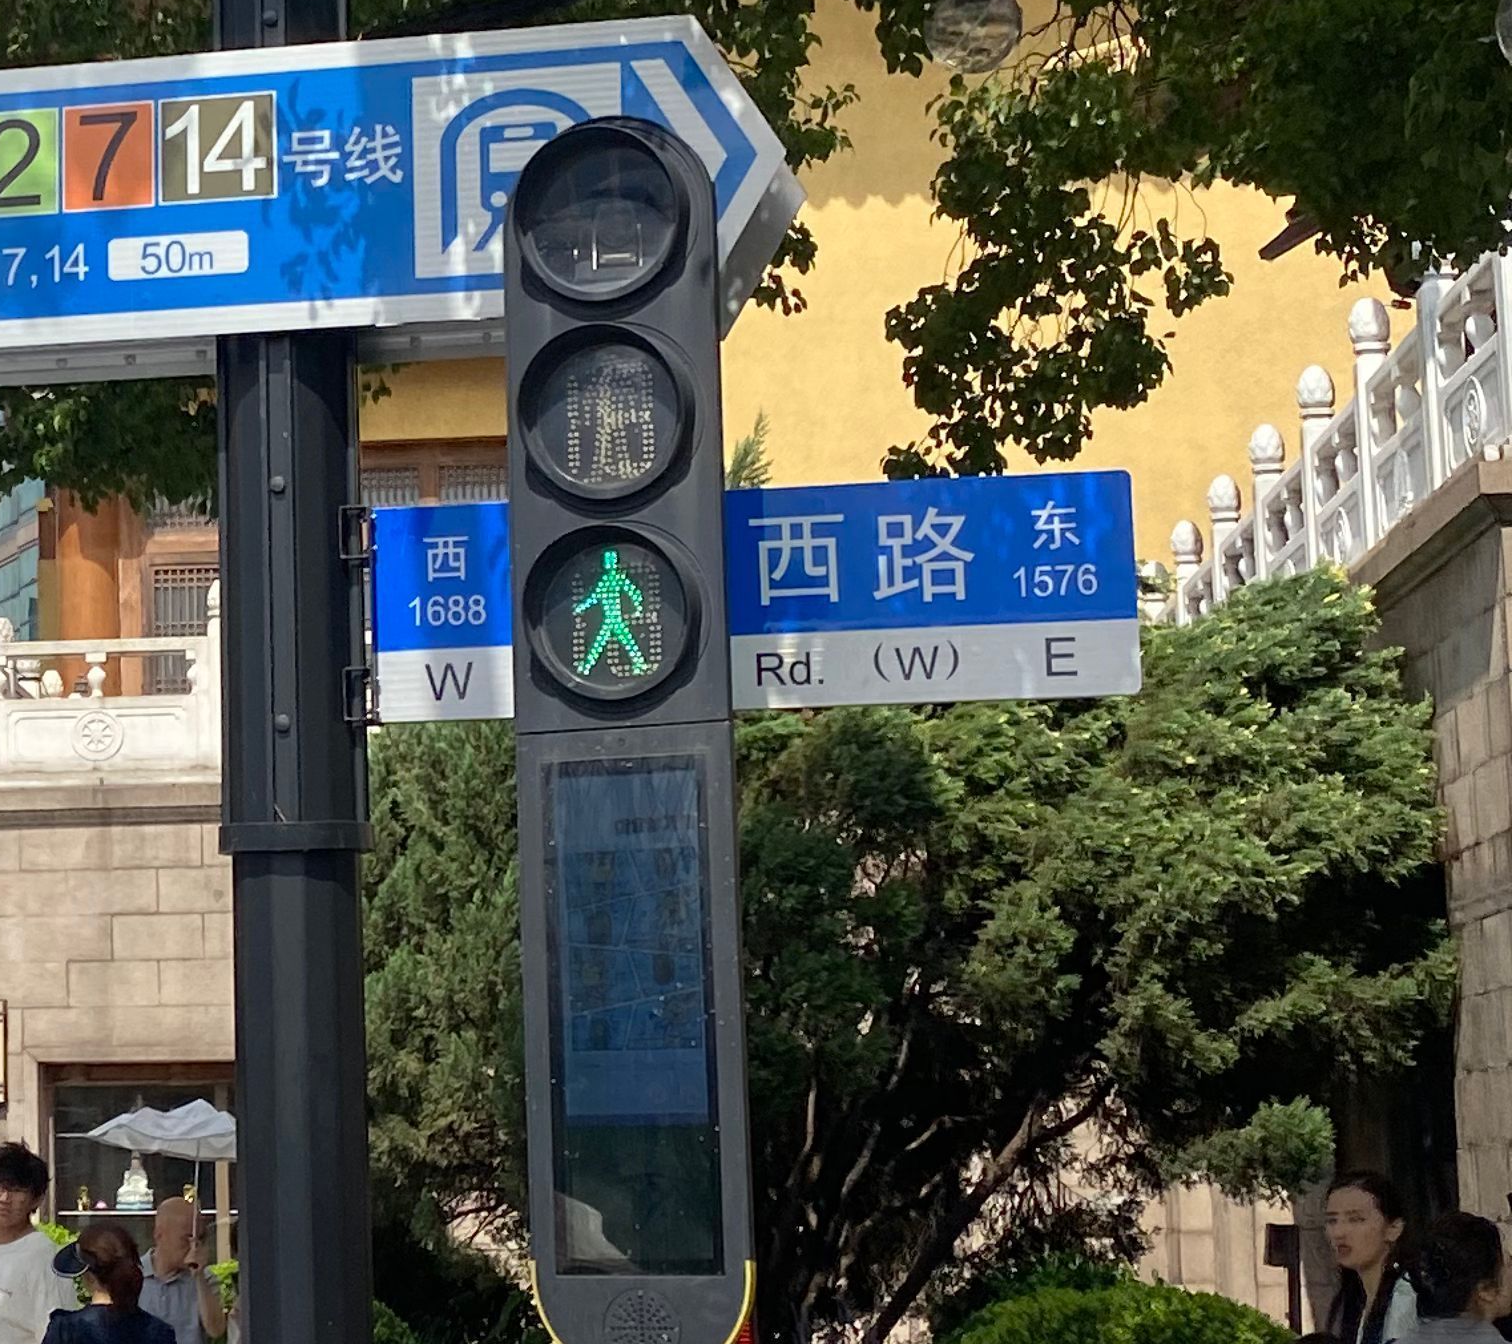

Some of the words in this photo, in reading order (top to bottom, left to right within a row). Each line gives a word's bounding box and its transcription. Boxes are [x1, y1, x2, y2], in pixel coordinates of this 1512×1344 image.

[78, 110, 139, 202] 7
[164, 99, 268, 196] 14
[282, 122, 405, 188] 号线
[140, 239, 214, 275] 50m
[1029, 499, 1082, 552] 东
[422, 535, 470, 583] 西
[747, 506, 976, 607] 西路
[1011, 562, 1100, 600] 1576
[407, 593, 487, 628] 1688
[754, 650, 826, 688] Rd.
[1043, 635, 1079, 678] E
[424, 660, 474, 702] W
